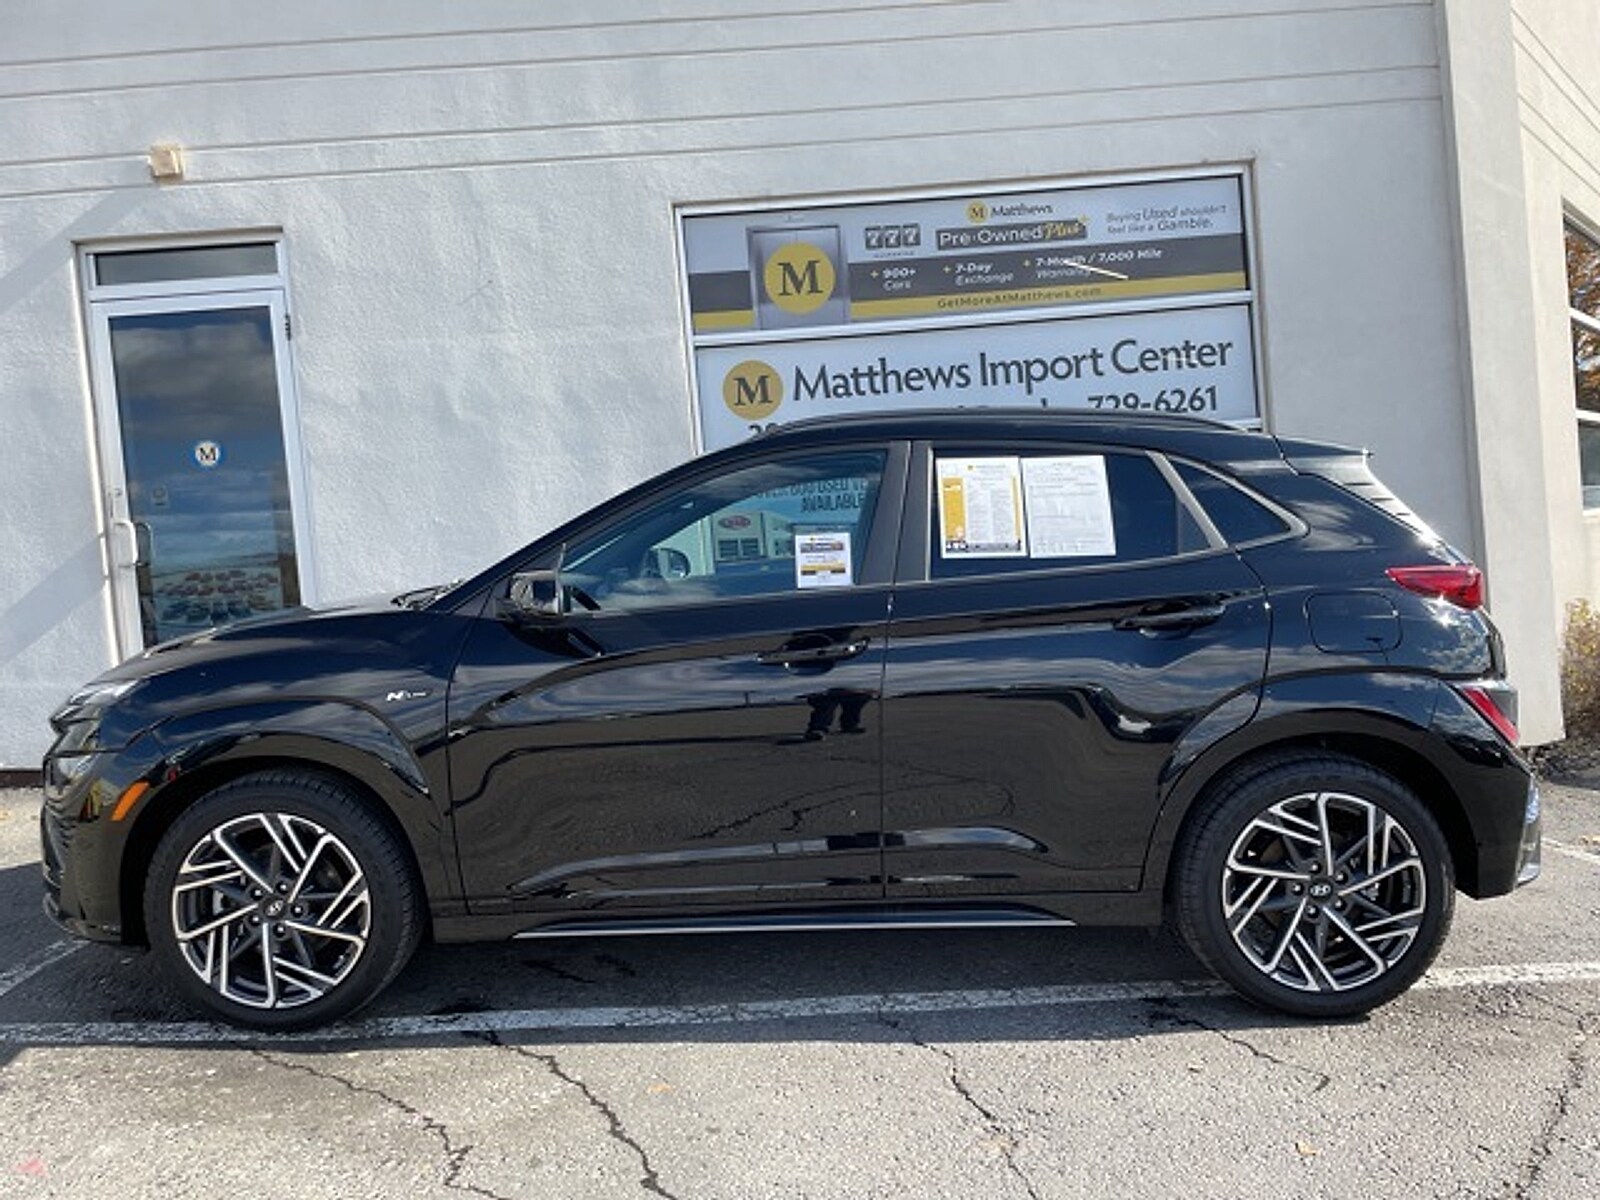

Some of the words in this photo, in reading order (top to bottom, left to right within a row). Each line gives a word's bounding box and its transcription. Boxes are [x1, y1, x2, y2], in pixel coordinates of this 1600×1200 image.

[991, 203, 1053, 217] Matthews
[1106, 209, 1140, 224] Buying
[1142, 205, 1178, 220] Used
[1107, 224, 1126, 235] feel
[1128, 222, 1146, 233] like
[1157, 216, 1214, 232] Gamble.
[939, 226, 1043, 247] Pre-Owned
[1098, 249, 1134, 264] 7,000
[1137, 247, 1163, 260] Mile
[777, 259, 824, 296] M
[955, 262, 993, 275] 7-Day
[955, 272, 1014, 287] Exchange
[937, 286, 1101, 308] GetMoreAtMatthews.com
[733, 374, 773, 406] M
[792, 356, 972, 402] Matthews
[978, 346, 1105, 395] Import
[1110, 337, 1234, 375] Center
[198, 446, 217, 462] M
